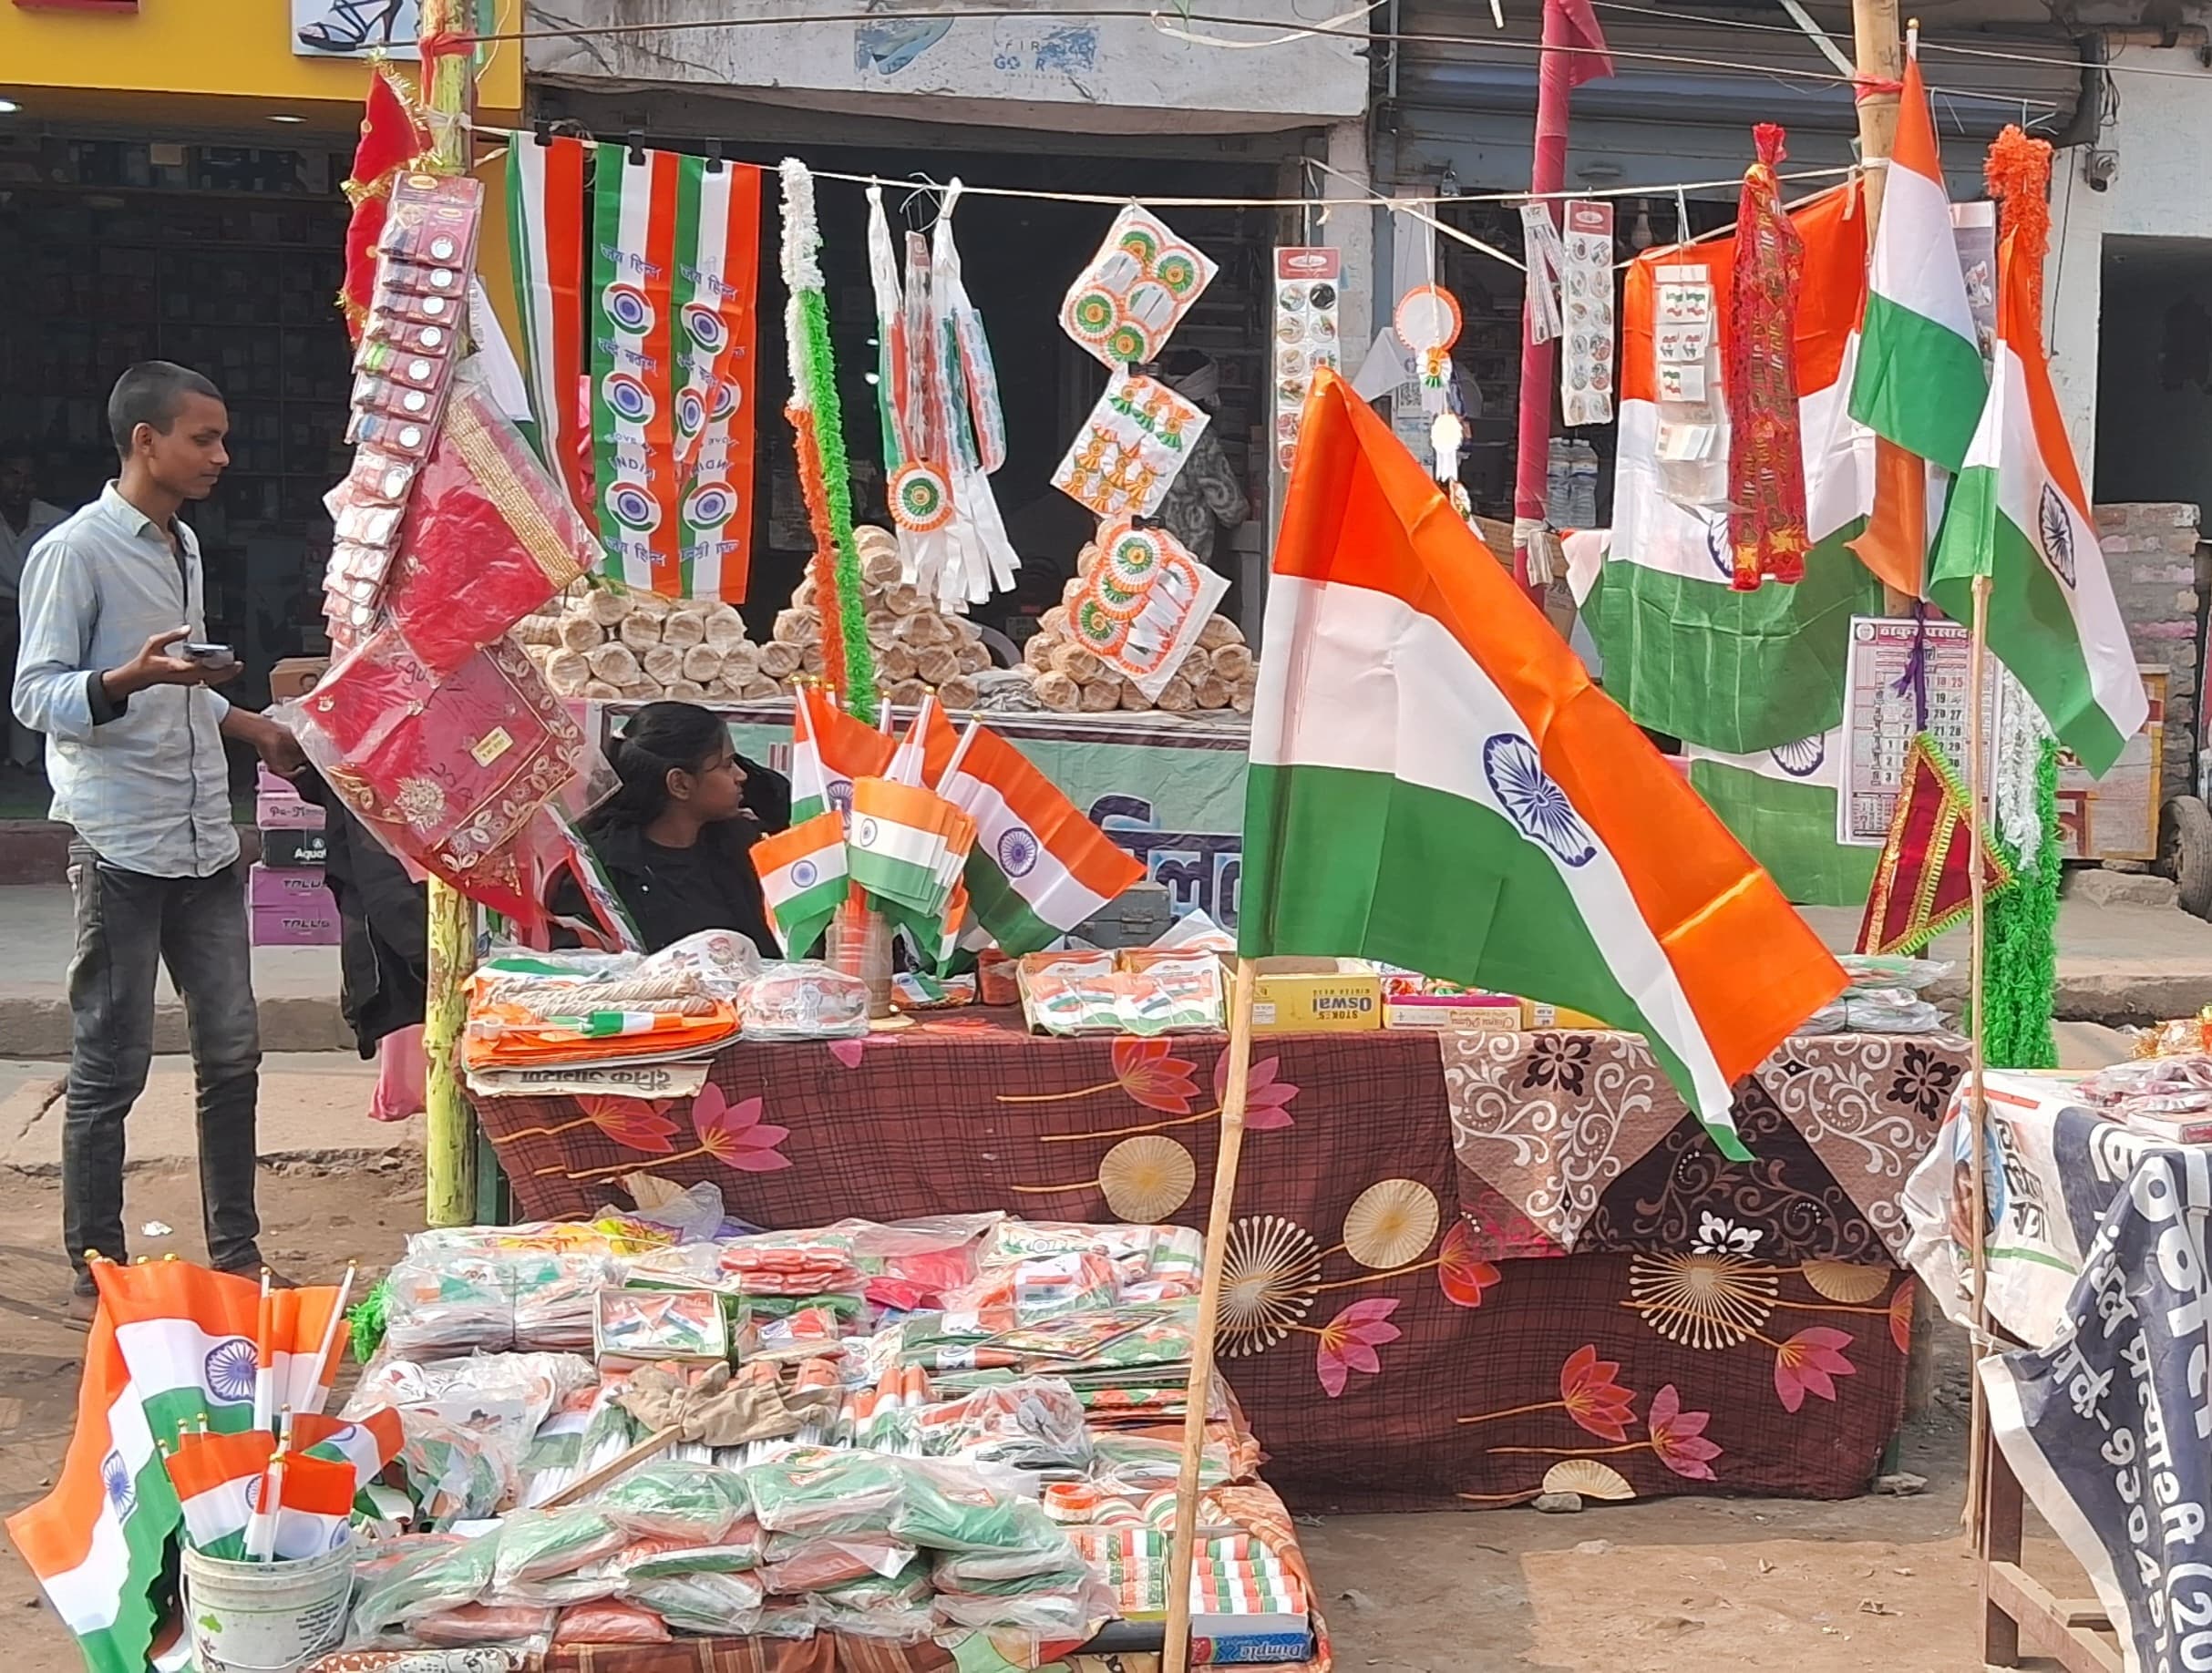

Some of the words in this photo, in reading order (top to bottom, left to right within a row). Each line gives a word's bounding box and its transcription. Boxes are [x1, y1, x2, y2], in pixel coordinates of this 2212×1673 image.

[1936, 693, 1946, 703] 19
[1950, 710, 1961, 720] 27
[1312, 997, 1372, 1012] Oswal
[611, 1070, 673, 1091] दैनिक
[2119, 1327, 2206, 1545] प्रत्याशी
[1240, 1641, 1305, 1661] Dimple
